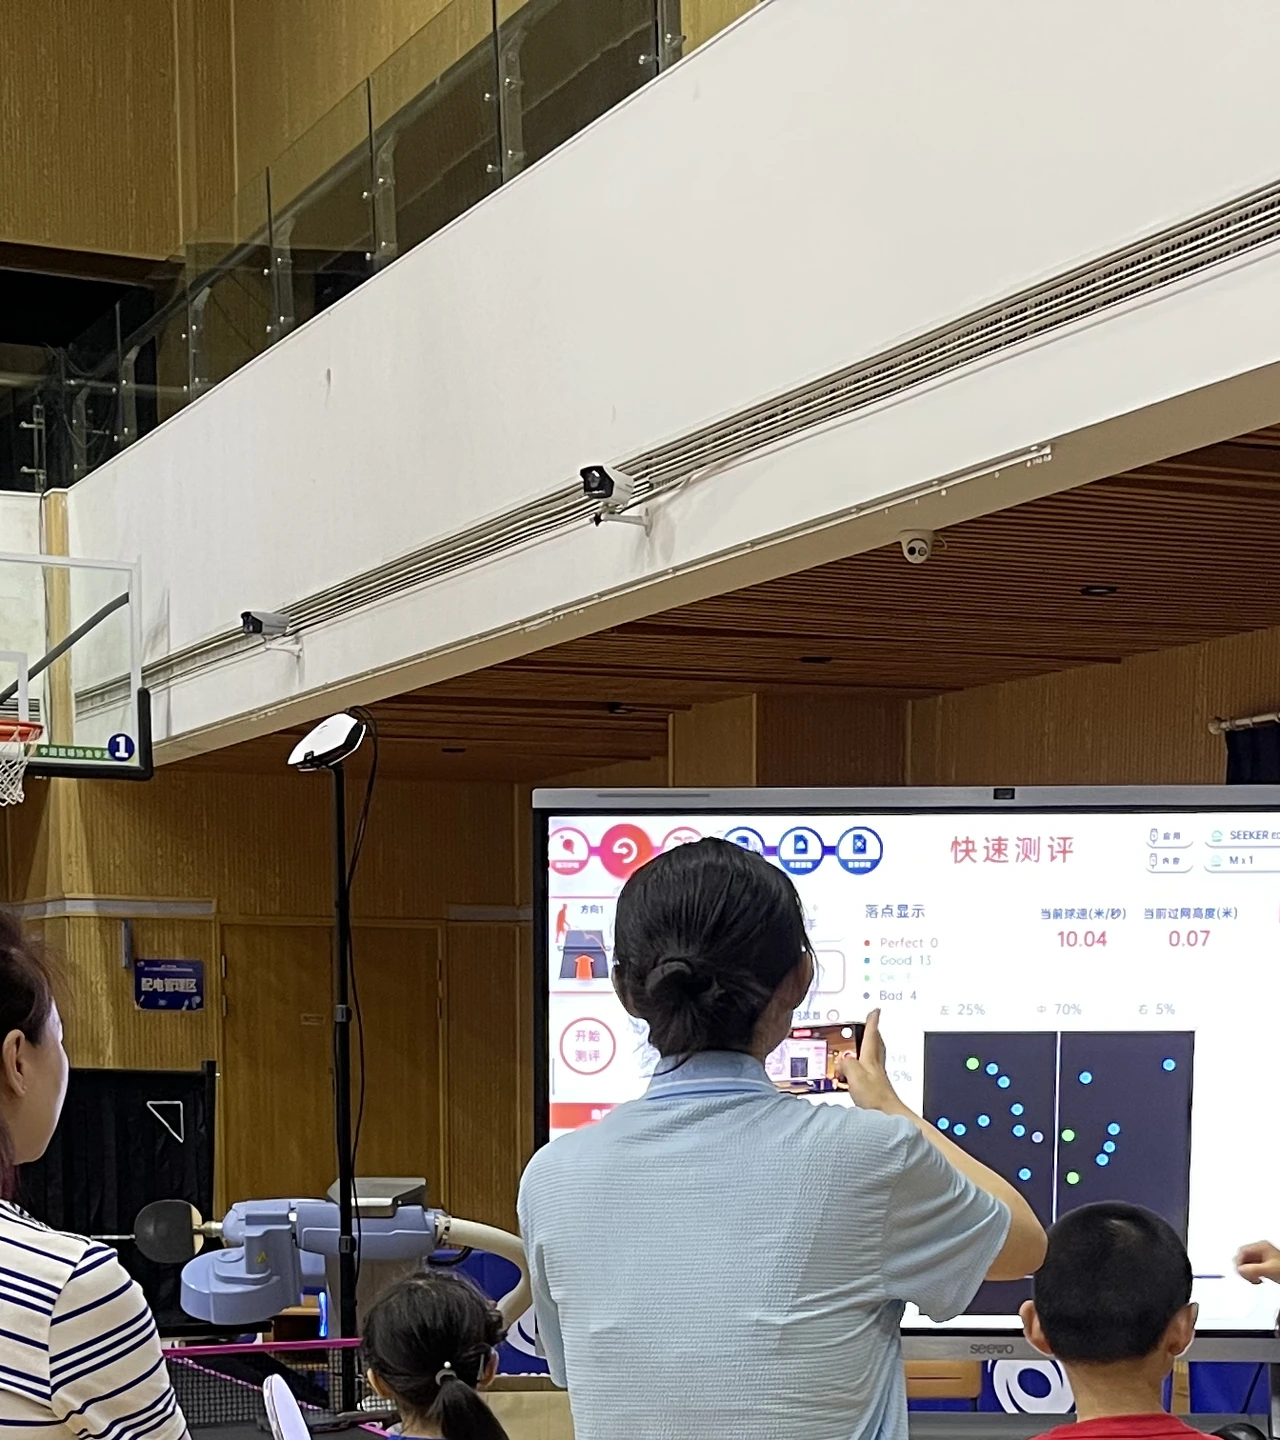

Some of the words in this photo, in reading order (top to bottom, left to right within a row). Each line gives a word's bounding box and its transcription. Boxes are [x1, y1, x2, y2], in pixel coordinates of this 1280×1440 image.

[114, 736, 129, 758] 1
[1230, 830, 1269, 840] SEEKER
[950, 835, 1074, 864] 快速测评
[865, 904, 925, 919] 落点显示
[1143, 907, 1238, 920] 当前过网高度(米)
[880, 937, 923, 948] Perfect
[931, 937, 938, 948] 0
[1057, 930, 1108, 947] 10.04
[1168, 930, 1211, 947] 0.07
[880, 956, 912, 966] Good
[879, 990, 903, 1001] Bad
[910, 991, 917, 1000] 4
[957, 1004, 986, 1015] 25%
[1055, 1004, 1082, 1015] 70%
[1156, 1003, 1175, 1014] 5%
[575, 1030, 600, 1042] 开始
[575, 1050, 600, 1062] 测评
[970, 1343, 1014, 1355] seewo
